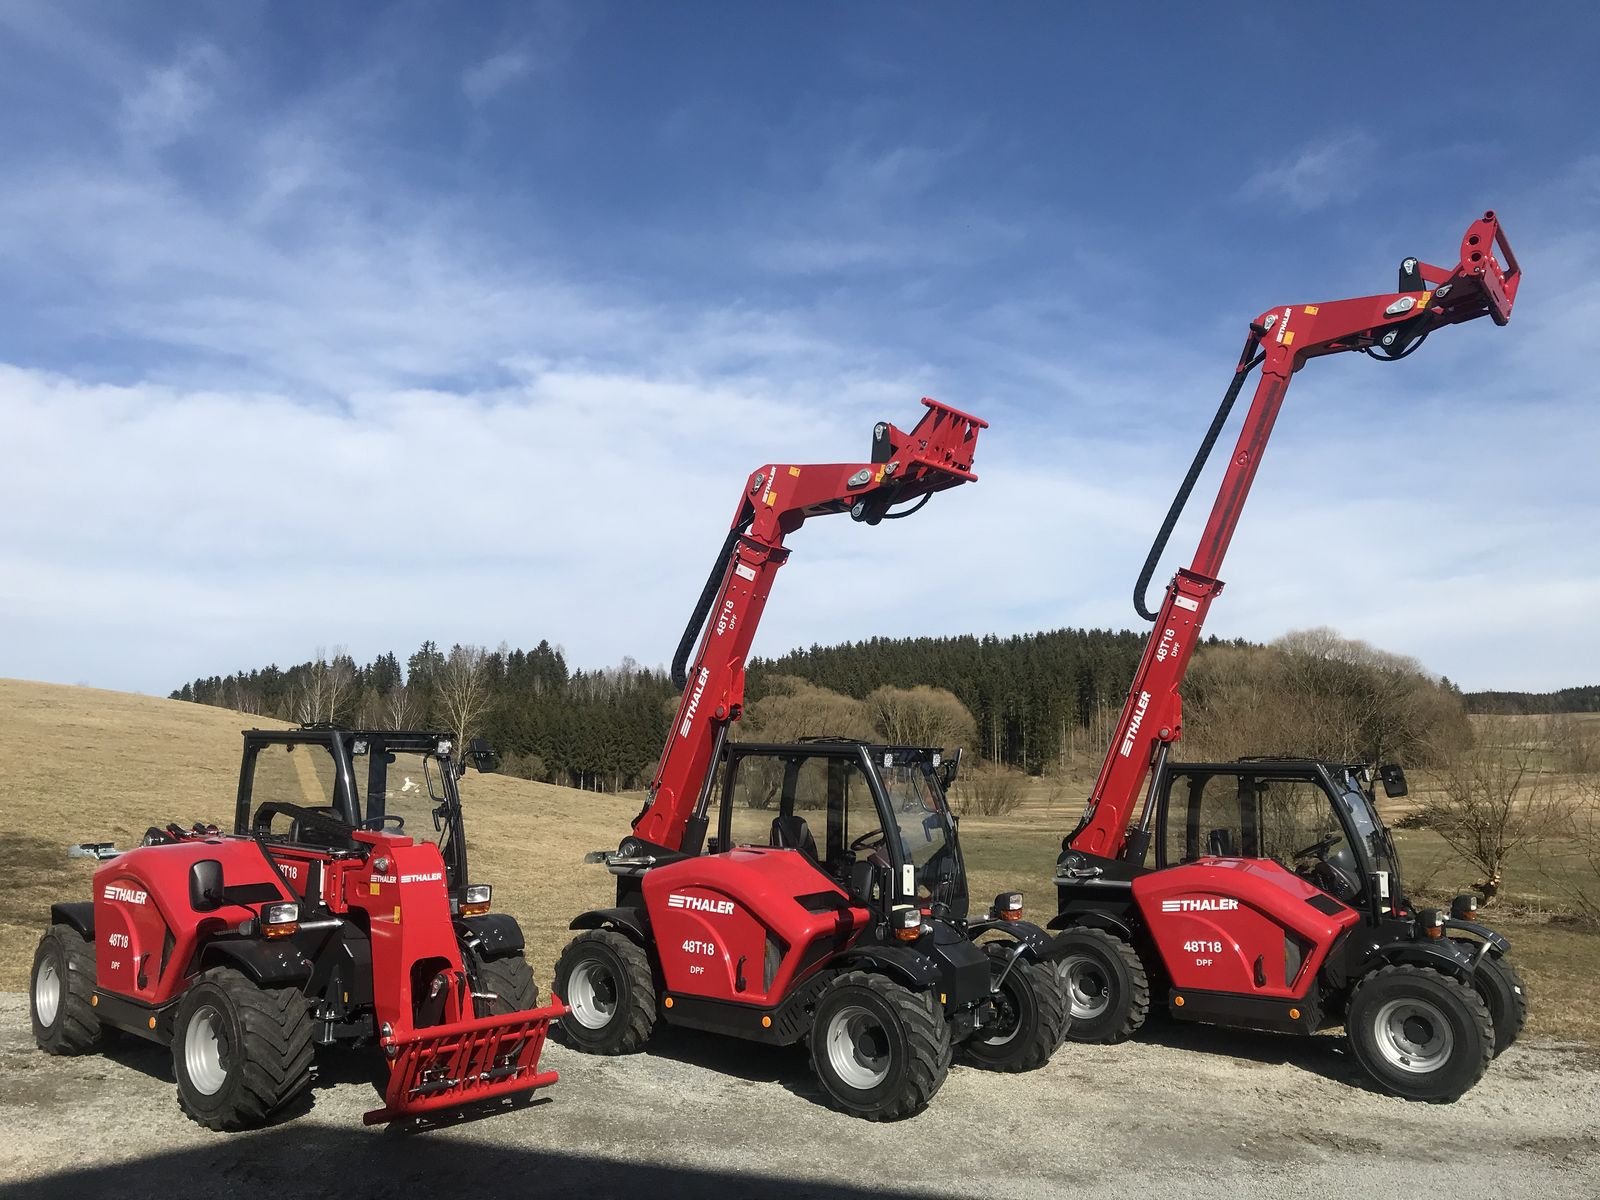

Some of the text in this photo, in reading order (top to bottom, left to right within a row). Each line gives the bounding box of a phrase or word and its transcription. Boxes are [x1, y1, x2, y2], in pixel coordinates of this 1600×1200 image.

[1279, 307, 1292, 335] THALER
[716, 599, 734, 637] 48T18
[729, 614, 738, 630] DPF
[1155, 628, 1176, 663] 48T18
[1170, 641, 1181, 658] DPF
[685, 667, 710, 721] THALER
[1126, 690, 1152, 741] THALER
[377, 874, 397, 884] THALER
[410, 872, 442, 883] THALER
[115, 887, 148, 905] THALER
[685, 895, 735, 915] THALER
[1180, 898, 1239, 912] THALER
[108, 933, 129, 949] 48T18
[682, 939, 715, 956] 48T18
[1183, 940, 1222, 953] 48T18
[111, 961, 120, 970] DPF
[690, 965, 705, 975] DPF
[1196, 958, 1213, 967] DPF
